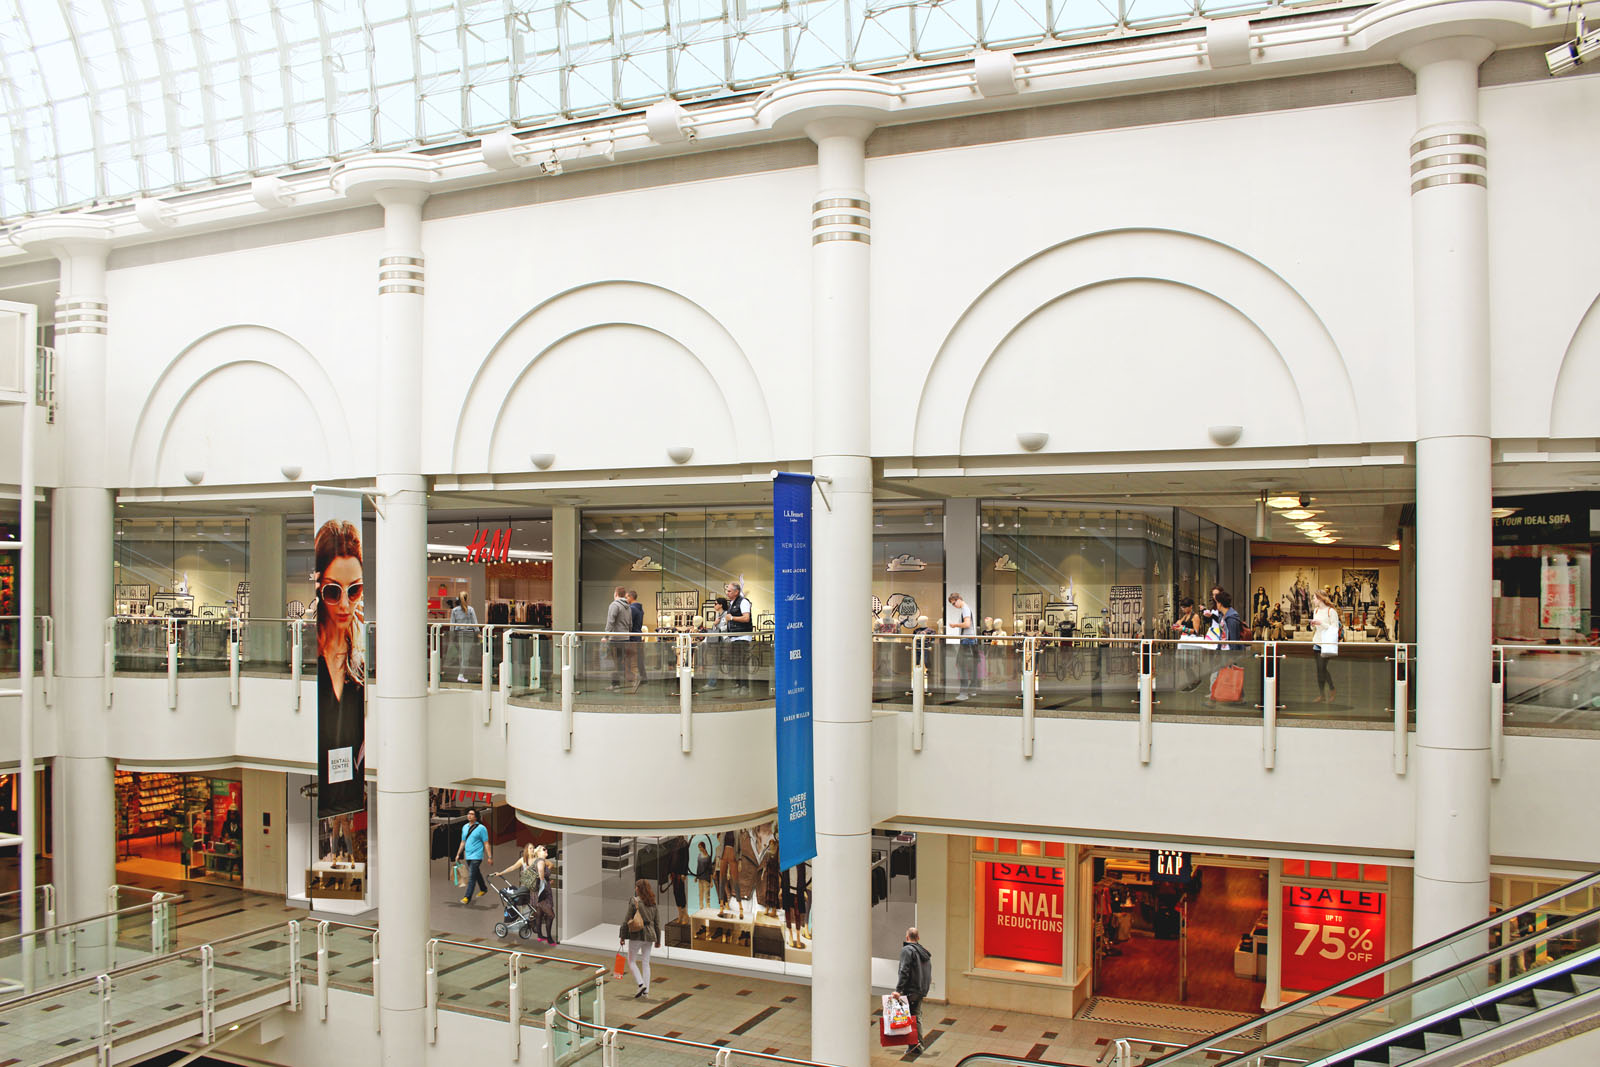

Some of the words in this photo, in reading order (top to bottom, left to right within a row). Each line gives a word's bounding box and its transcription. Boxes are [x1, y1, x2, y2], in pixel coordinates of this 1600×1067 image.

[1502, 516, 1522, 527] YOUR
[1524, 514, 1547, 525] IDEAL
[1548, 513, 1571, 525] SOFA
[466, 528, 512, 564] H&M
[787, 621, 804, 630] JAEGER
[790, 649, 802, 660] DIESEL
[789, 792, 807, 803] WHERE
[790, 801, 806, 813] STYLE
[789, 809, 807, 822] REIGNS
[1000, 864, 1064, 880] SALE
[1157, 855, 1183, 876] GAP
[998, 888, 1063, 919] FINAL
[1299, 887, 1372, 906] SALE
[997, 914, 1063, 933] REDUCTIONS
[1294, 922, 1374, 960] 75%
[1347, 951, 1373, 963] OFF
